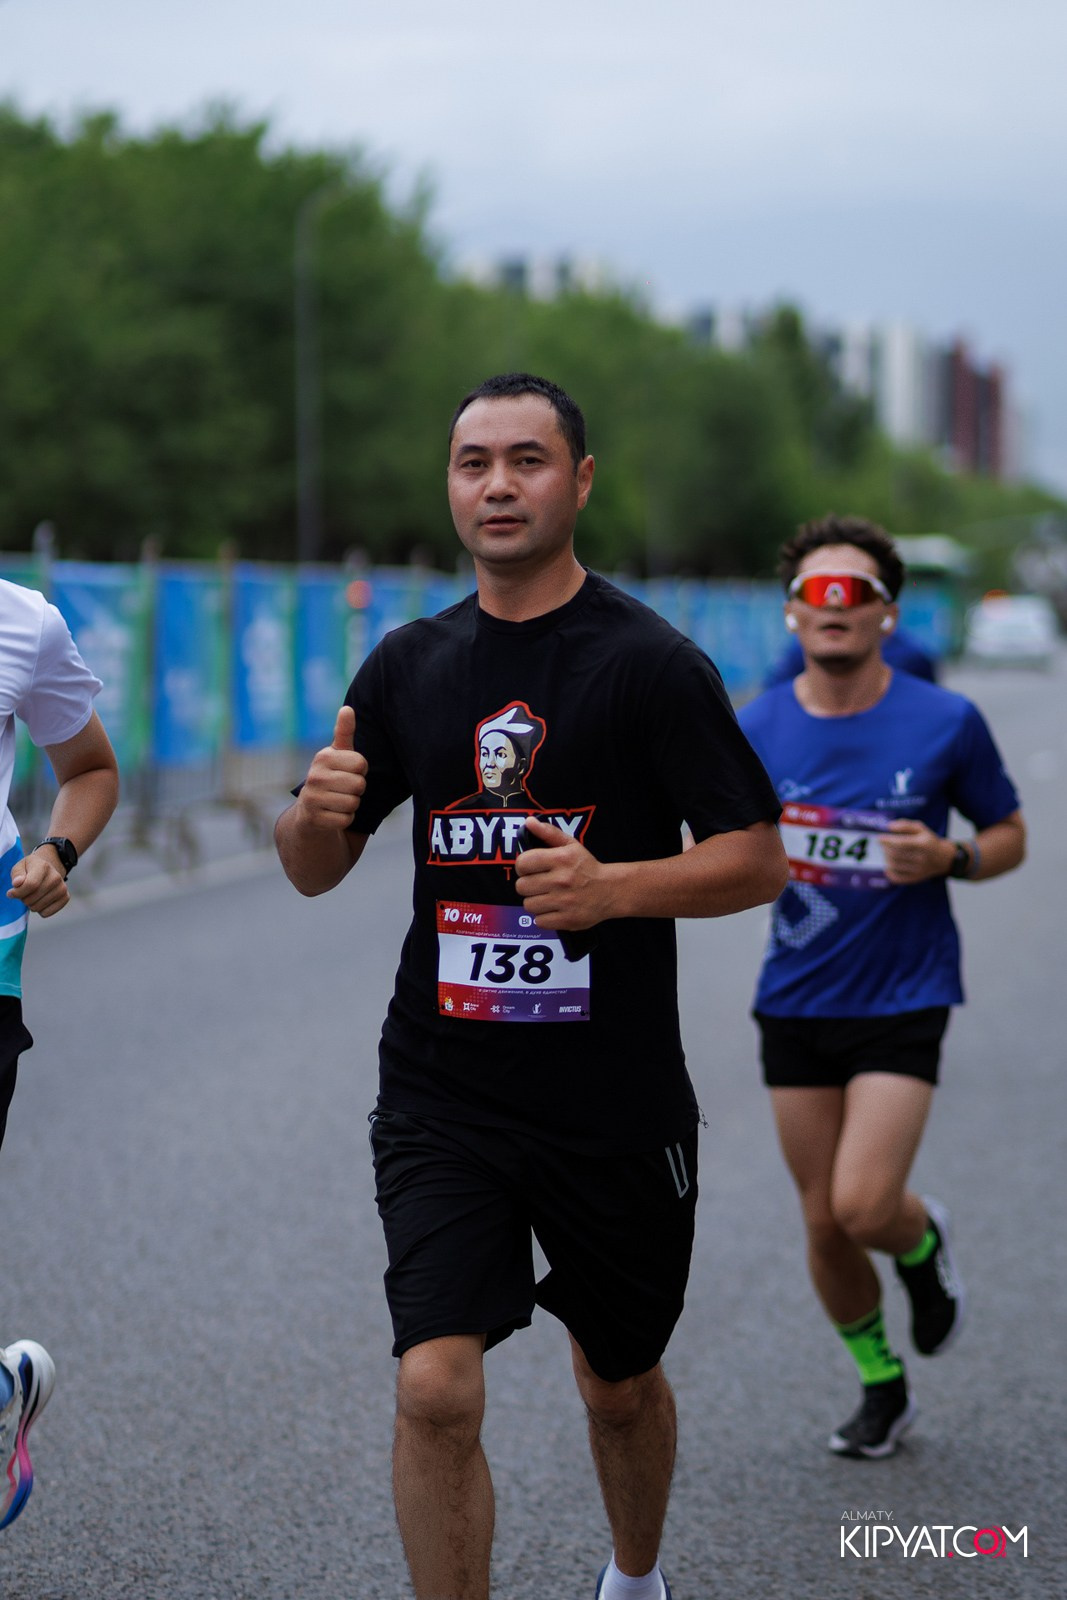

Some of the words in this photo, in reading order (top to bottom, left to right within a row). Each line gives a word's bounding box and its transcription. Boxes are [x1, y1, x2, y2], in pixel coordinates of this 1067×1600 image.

[431, 815, 584, 855] ABYRY
[806, 833, 869, 862] 184
[443, 908, 460, 922] 10
[469, 942, 554, 984] 138
[559, 1005, 582, 1013] INVICTUS
